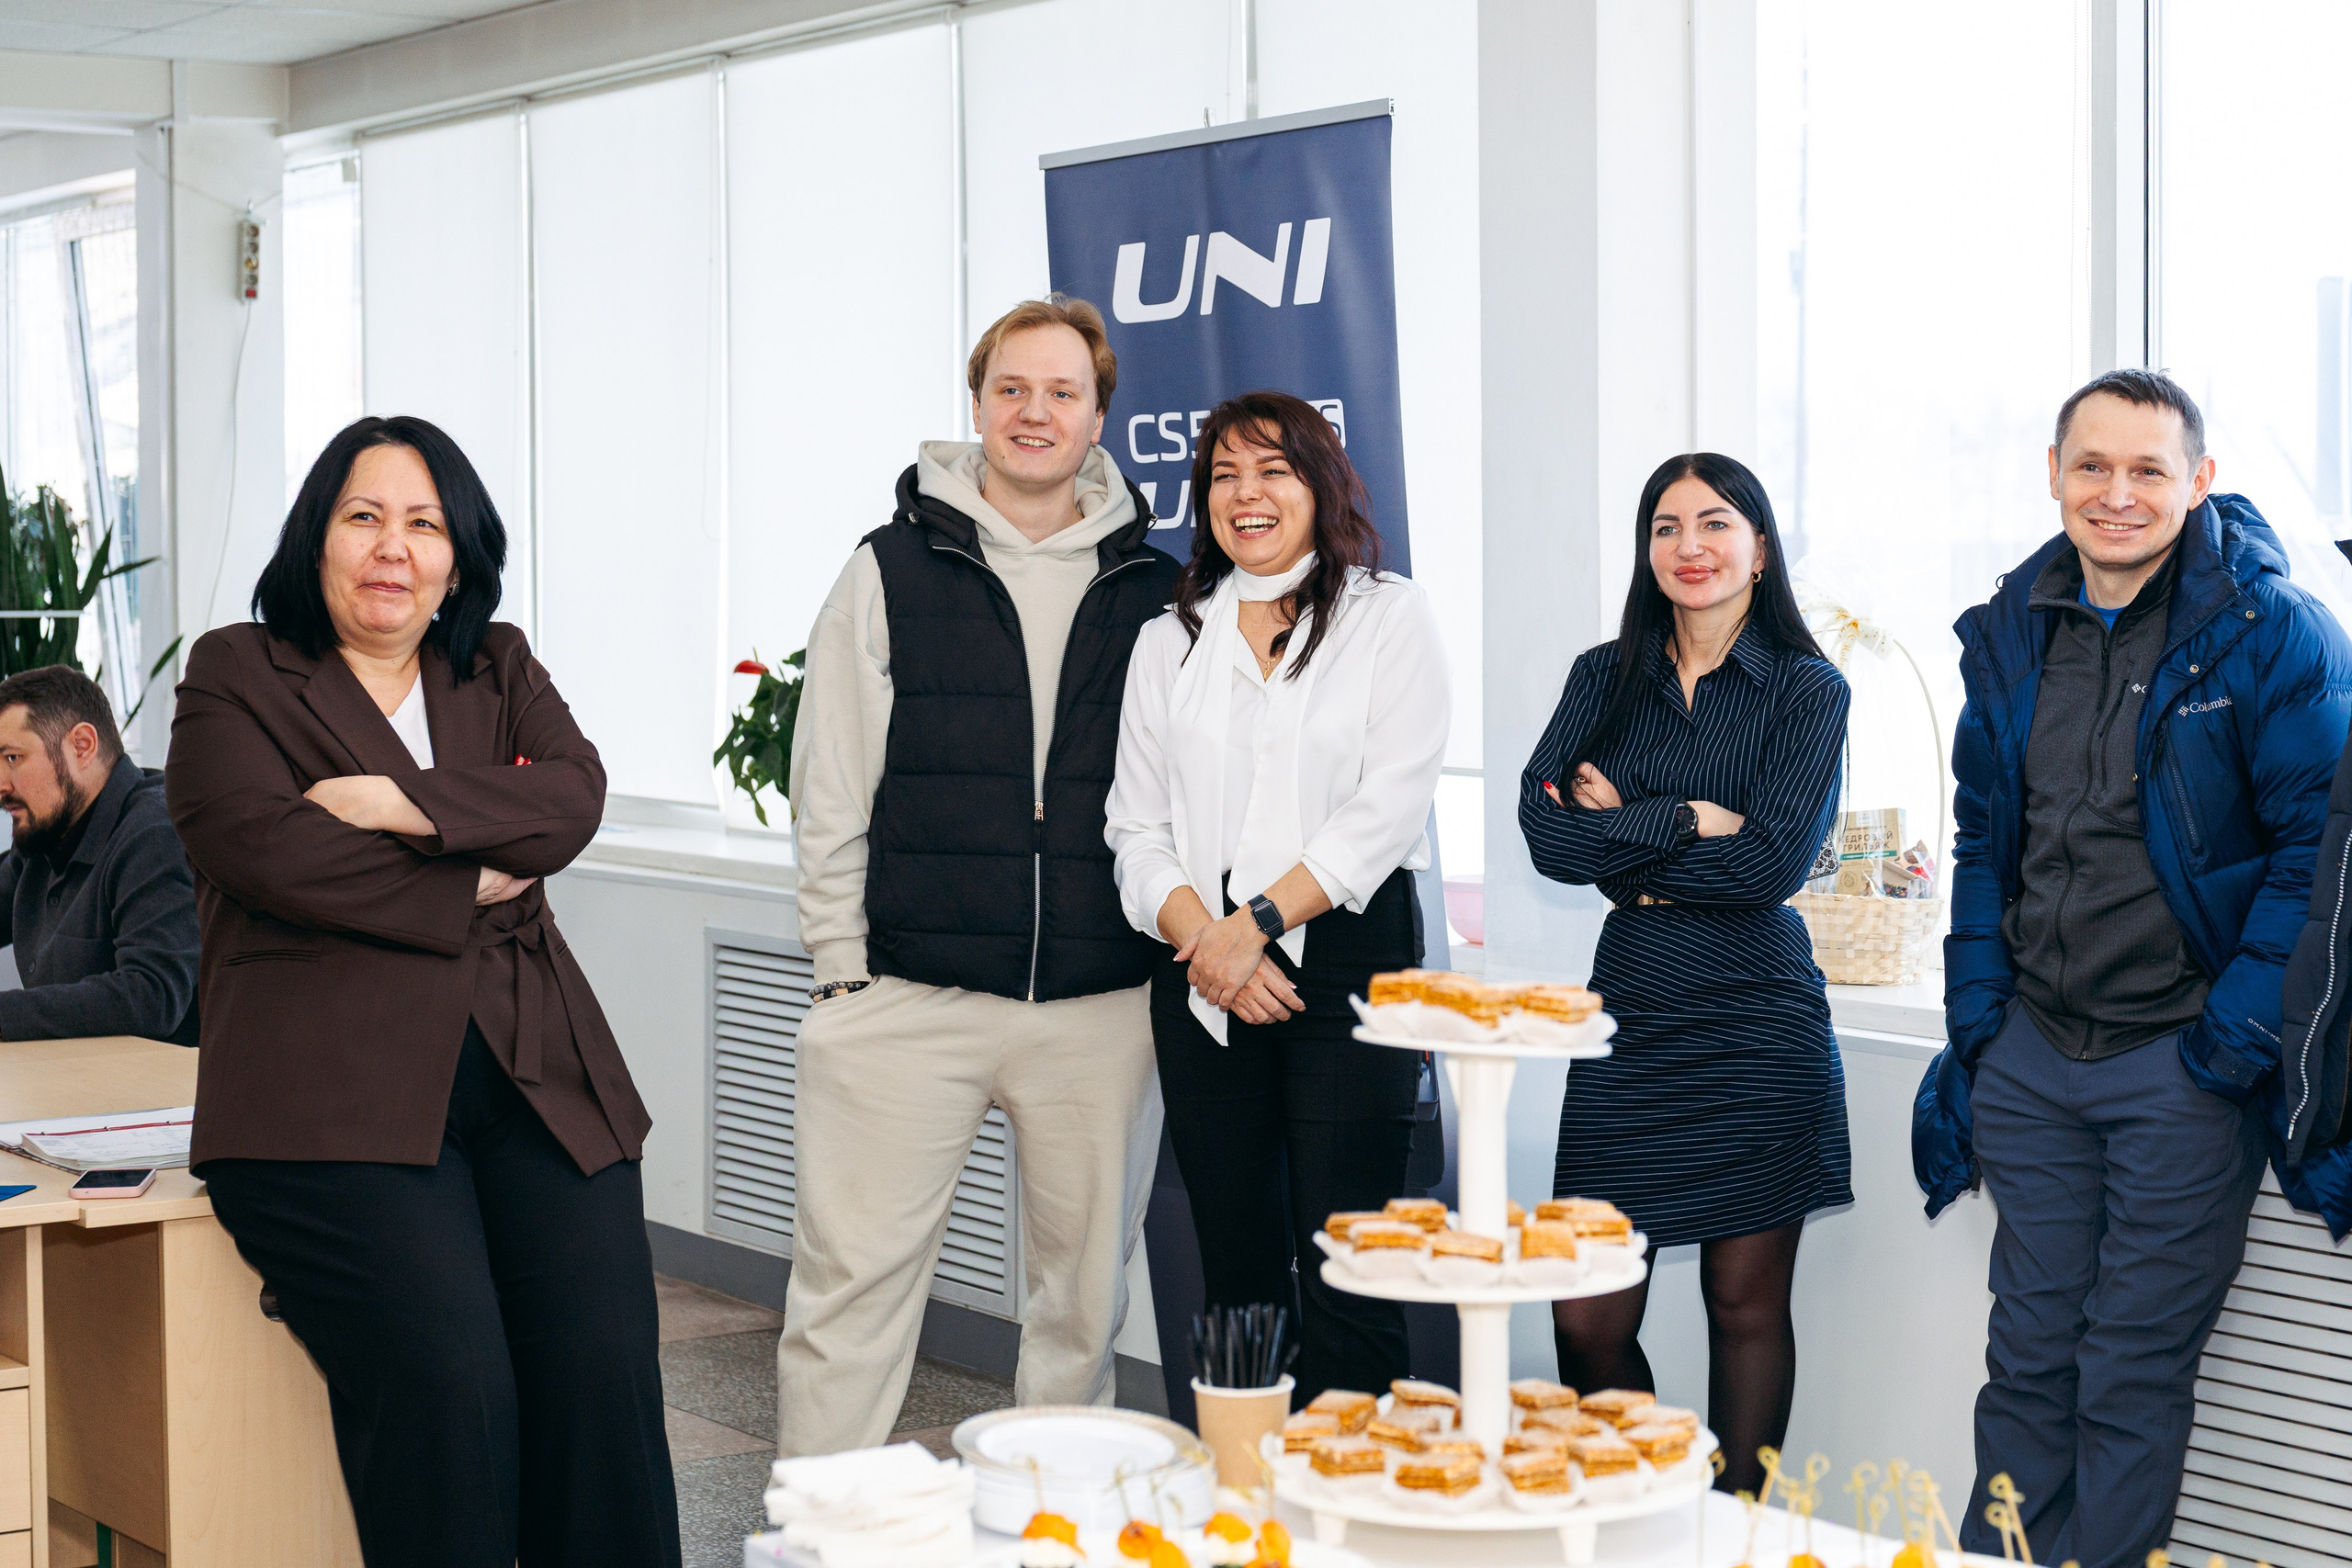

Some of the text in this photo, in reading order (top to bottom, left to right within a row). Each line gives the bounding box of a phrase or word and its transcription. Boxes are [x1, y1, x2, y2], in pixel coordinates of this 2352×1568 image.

[1112, 217, 1332, 324] UNI
[2189, 695, 2233, 713] Columbia
[2247, 1018, 2282, 1044] OMNI-HE
